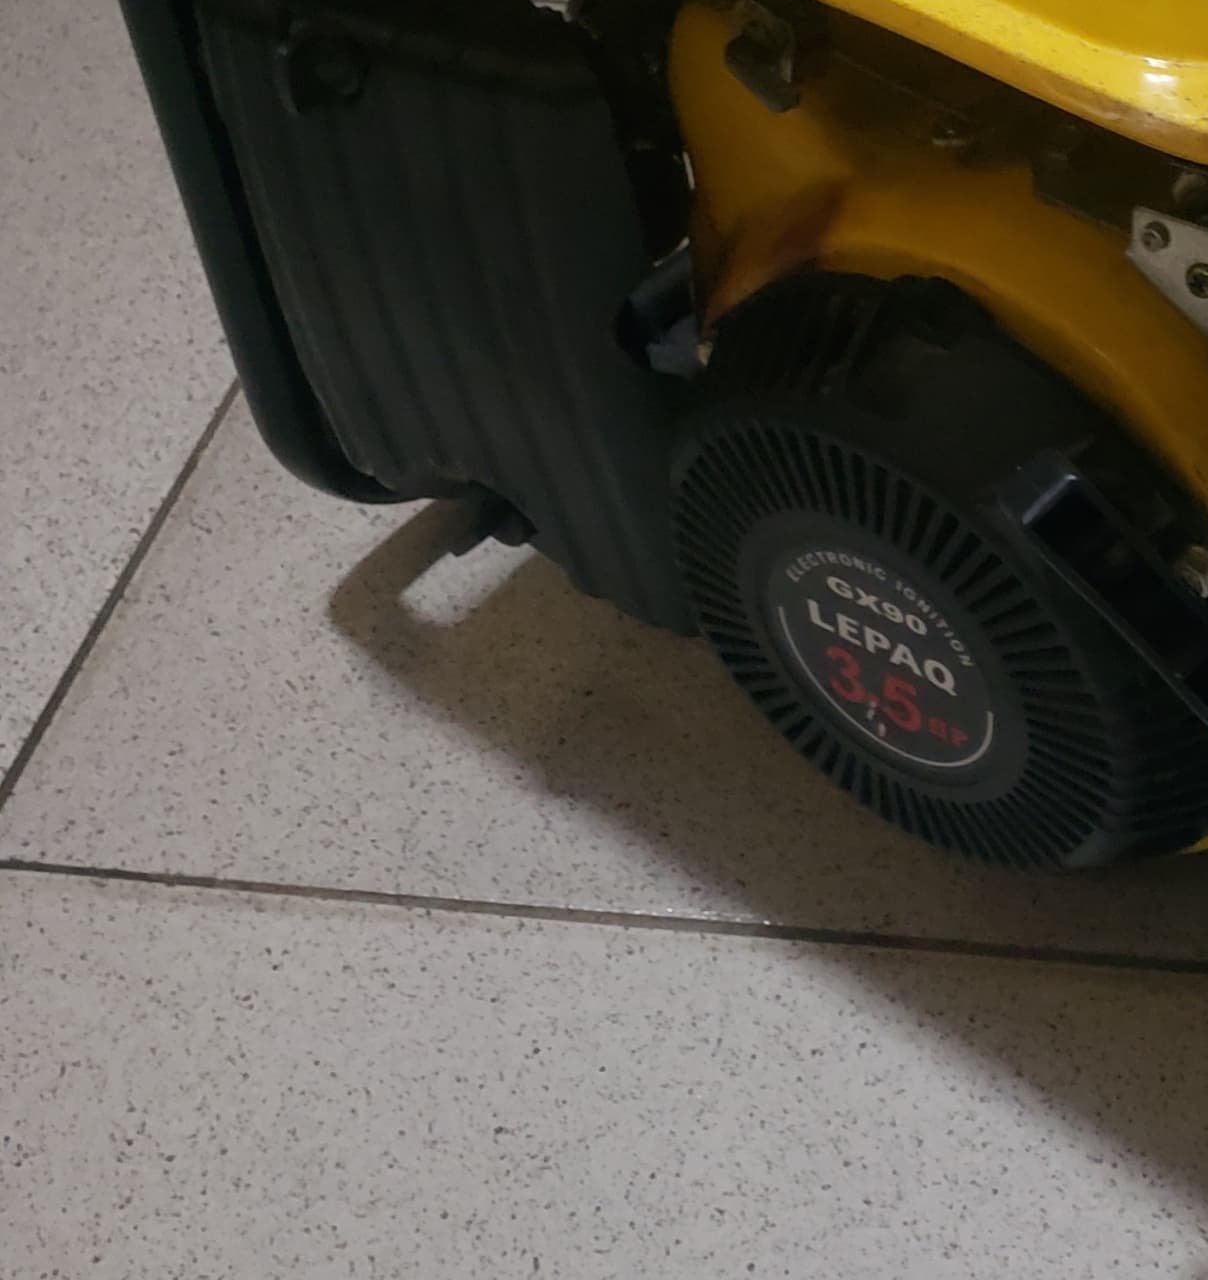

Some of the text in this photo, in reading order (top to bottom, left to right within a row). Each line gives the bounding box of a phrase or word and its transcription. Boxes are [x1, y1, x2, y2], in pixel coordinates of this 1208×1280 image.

[785, 551, 974, 666] ELECTRONIC IGNITION
[807, 598, 958, 696] LEPAQ
[826, 576, 928, 636] GX90
